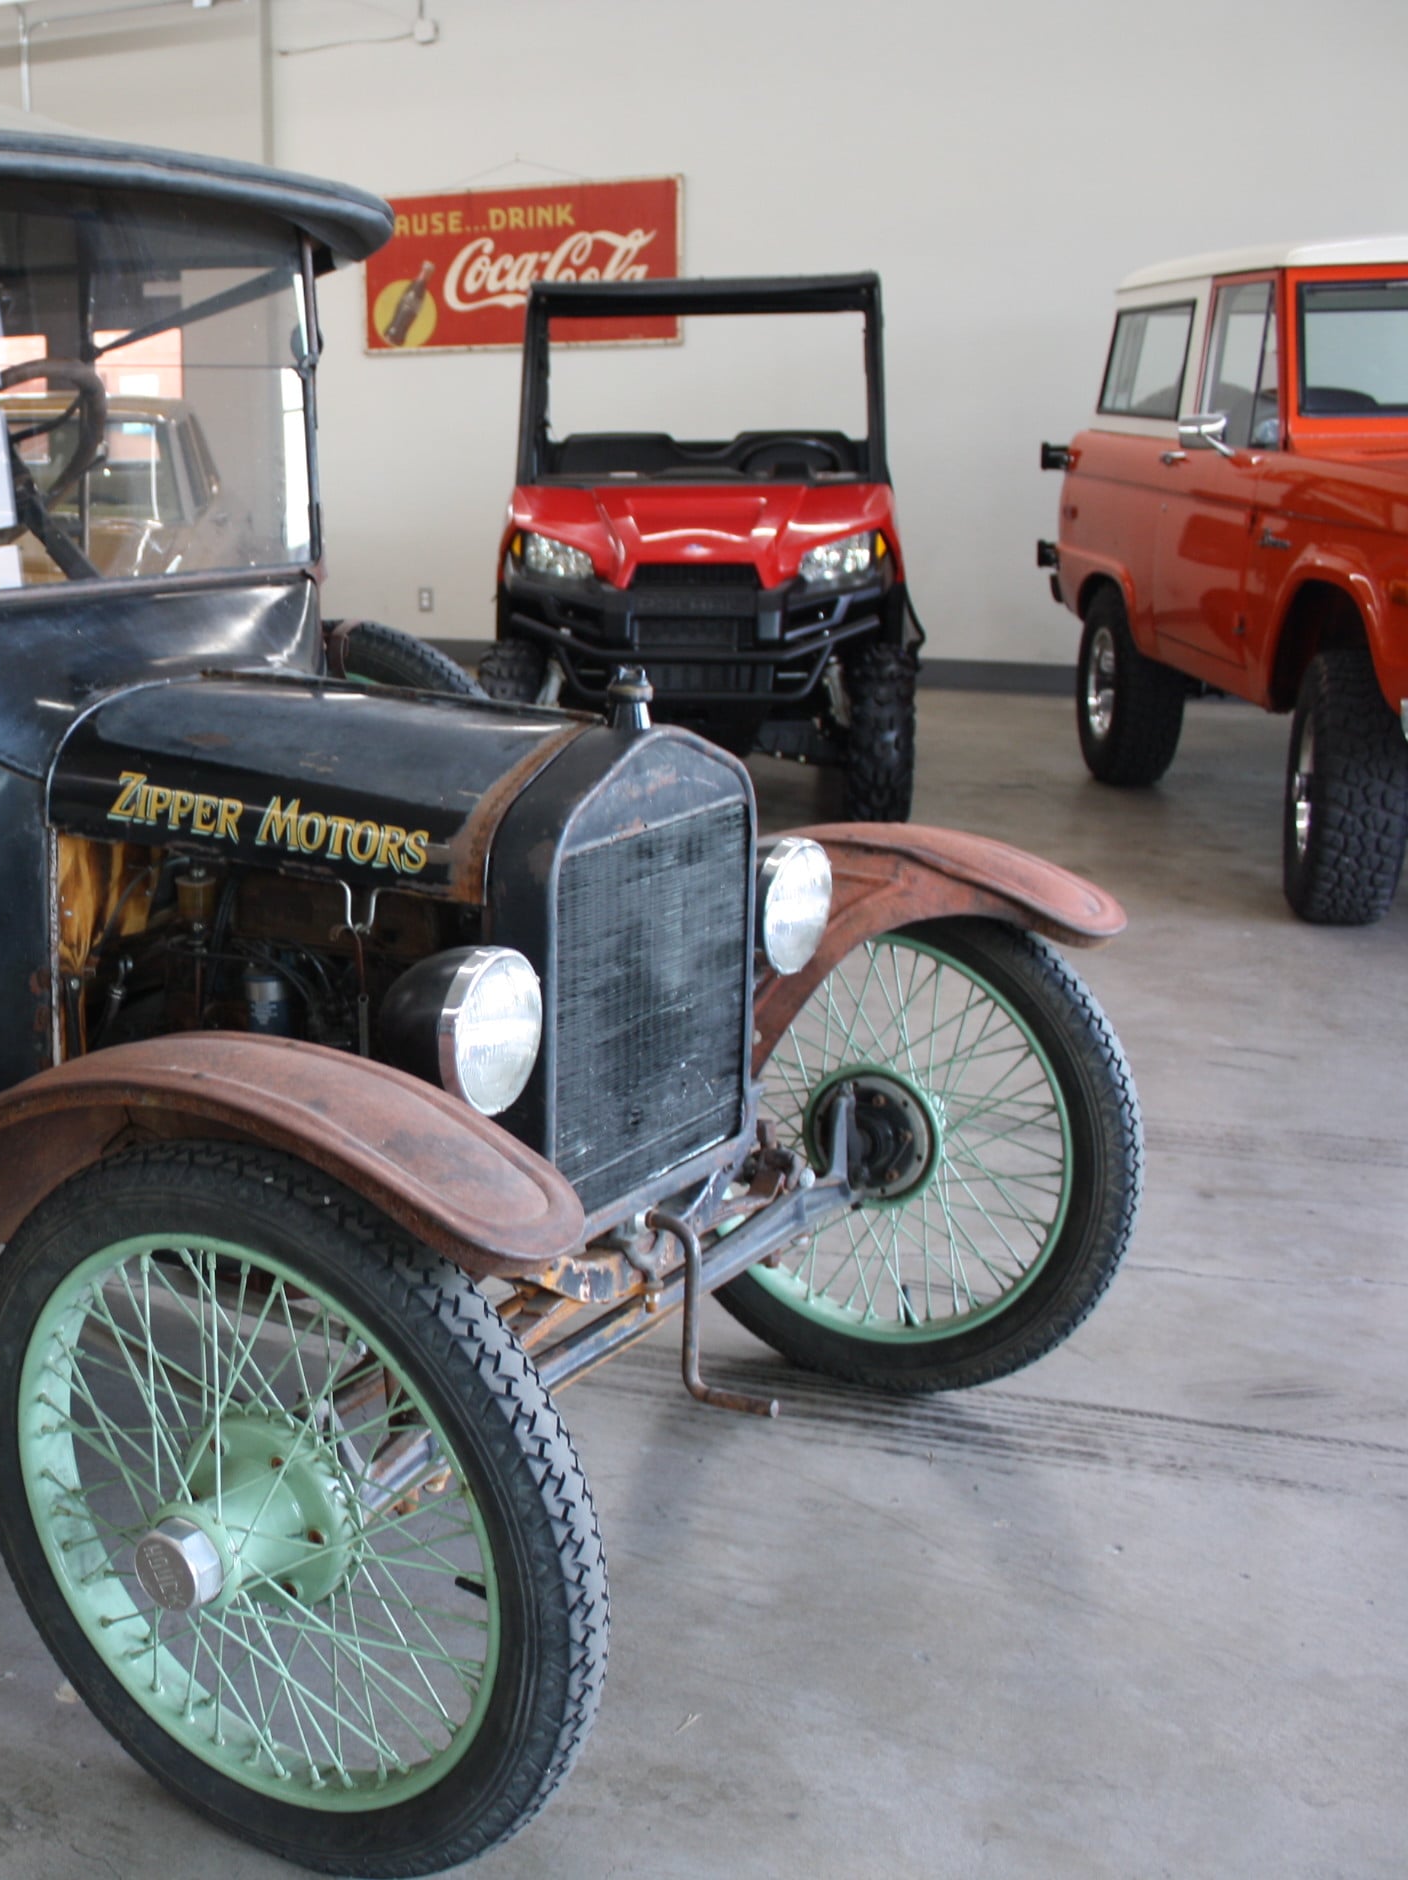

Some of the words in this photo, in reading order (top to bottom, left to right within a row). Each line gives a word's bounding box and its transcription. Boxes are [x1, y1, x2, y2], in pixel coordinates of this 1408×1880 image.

[393, 204, 575, 238] AUSE...DRINK
[106, 770, 243, 845] ZIPPER
[255, 795, 430, 874] MOTORS
